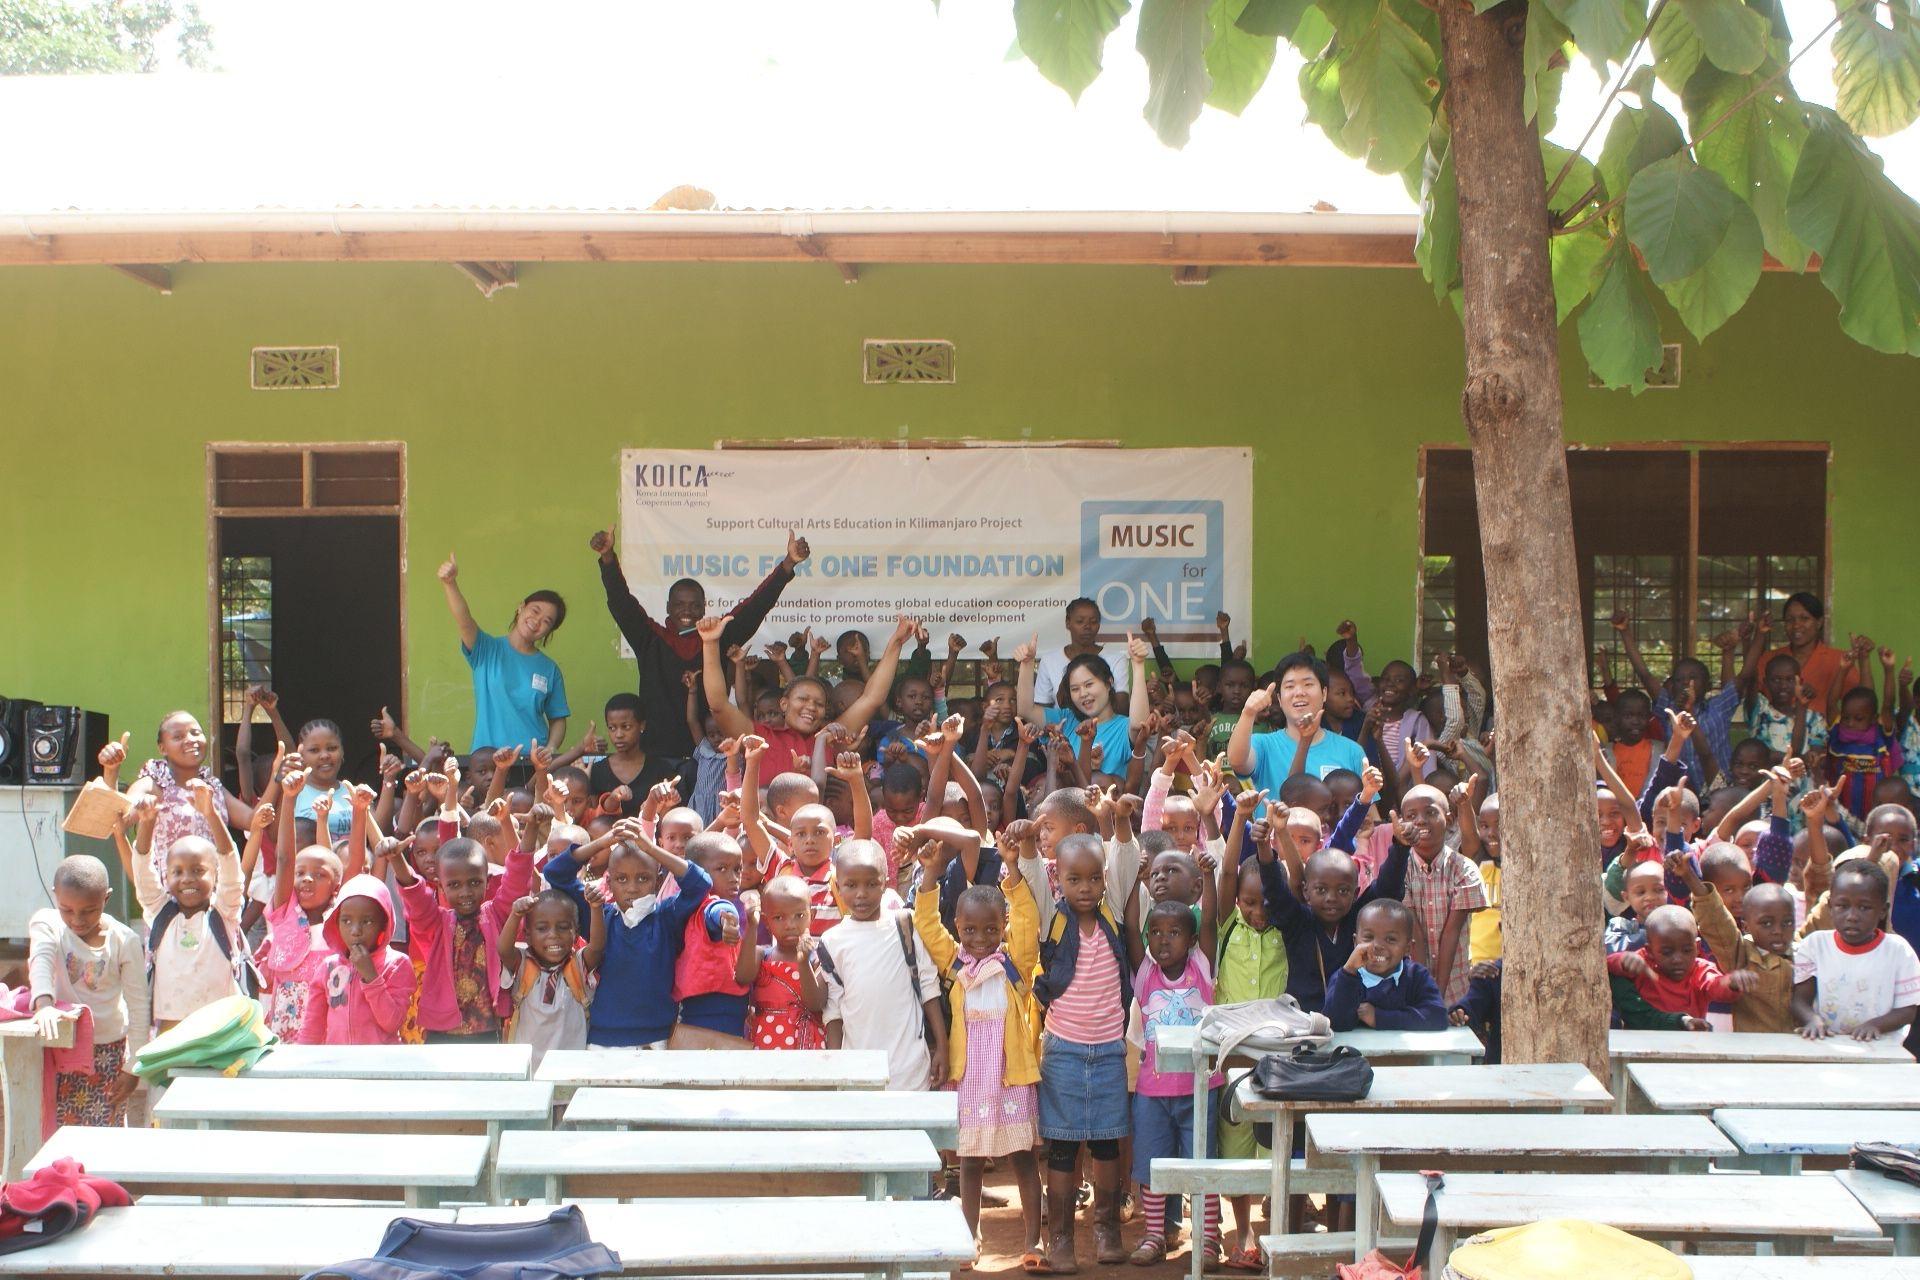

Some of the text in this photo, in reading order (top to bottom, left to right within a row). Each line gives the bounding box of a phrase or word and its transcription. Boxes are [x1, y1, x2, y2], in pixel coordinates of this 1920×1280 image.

[636, 464, 708, 487] KOICA
[637, 489, 708, 497] Korea International
[636, 498, 710, 507] Cooperation Agency
[706, 517, 1022, 531] Support Cultural Arts Education in Kilimanjaro Project
[1111, 524, 1195, 547] MUSIC
[663, 555, 750, 577] MUSIC
[821, 555, 878, 577] ONE
[887, 555, 1064, 577] FOUNDATION
[1182, 563, 1207, 578] for
[718, 598, 735, 608] for
[775, 598, 832, 608] oundation
[835, 599, 891, 610] promotes
[895, 598, 931, 610] global
[934, 598, 993, 608] education
[996, 598, 1067, 610] cooperation
[1097, 581, 1206, 622] ONE
[771, 612, 809, 622] music
[812, 612, 822, 622] to
[825, 613, 874, 624] promote
[949, 612, 1026, 624] development
